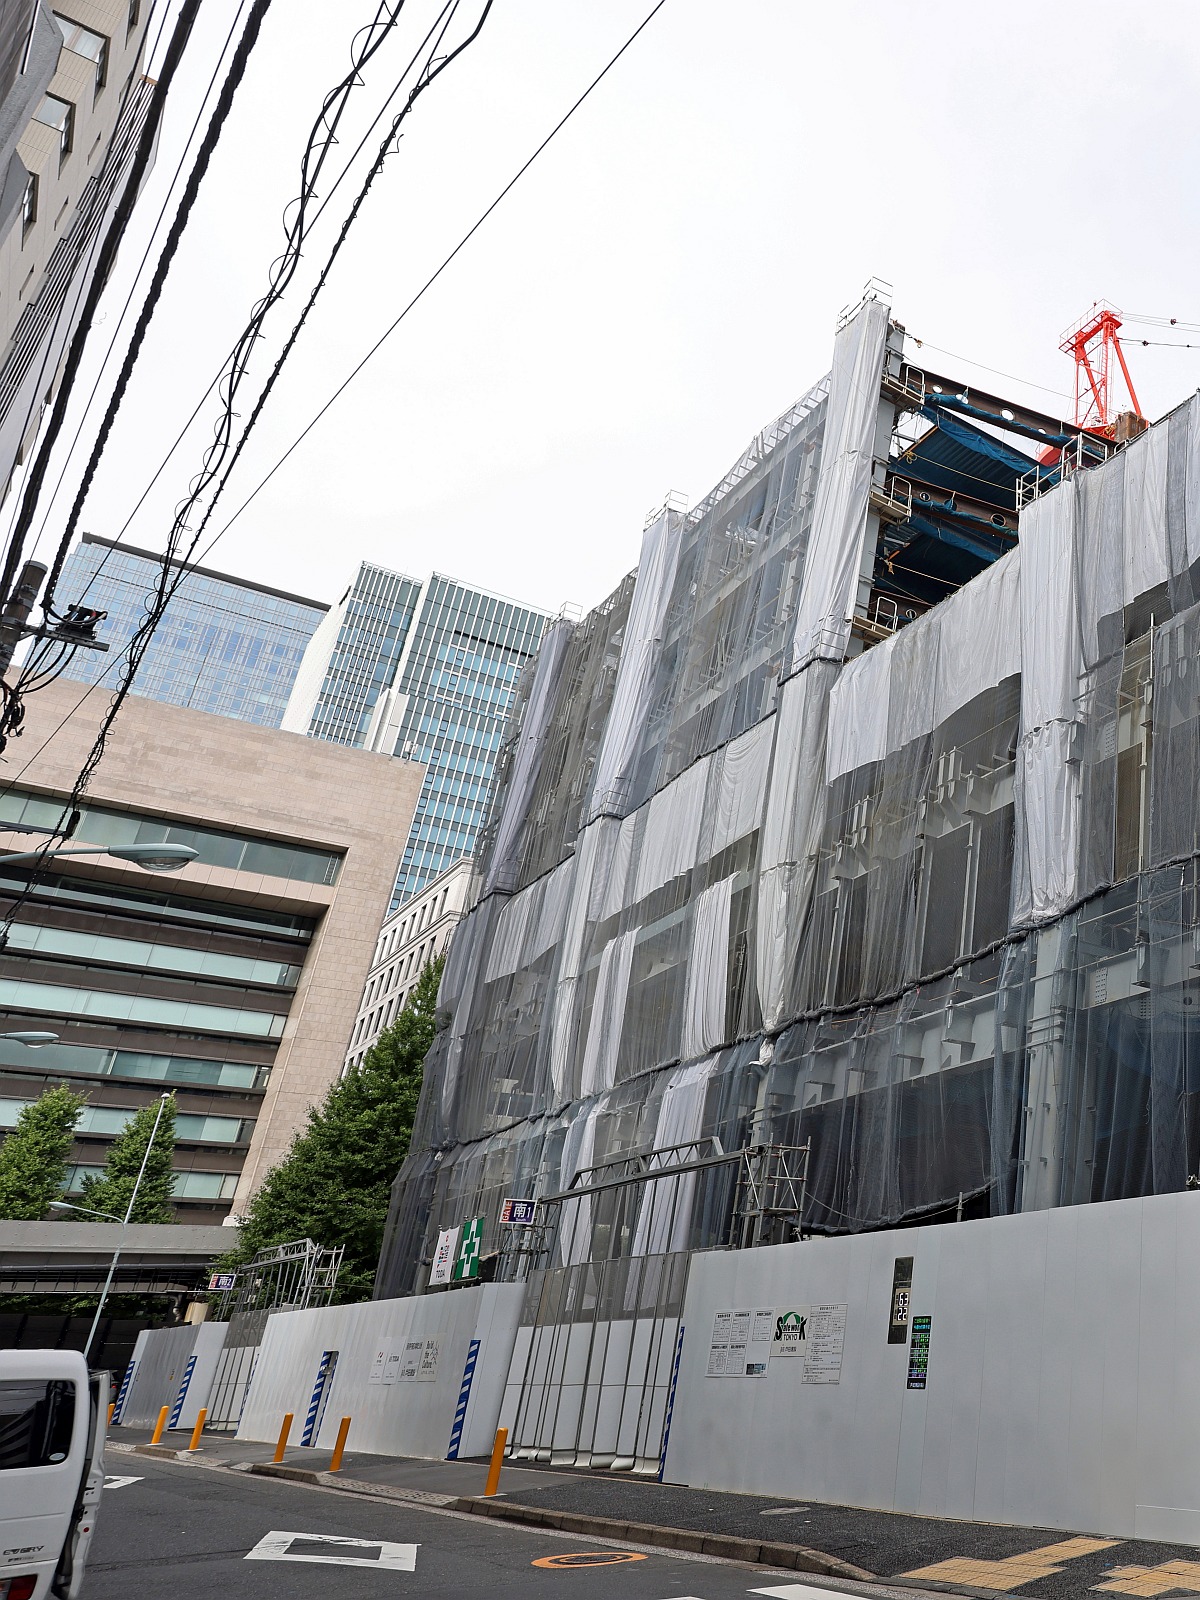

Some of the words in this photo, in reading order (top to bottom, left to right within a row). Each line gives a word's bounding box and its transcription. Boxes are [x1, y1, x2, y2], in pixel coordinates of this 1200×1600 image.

[503, 1201, 513, 1221] GATE
[899, 1292, 909, 1306] 63
[897, 1307, 908, 1321] 22
[3, 1546, 44, 1555] EVERY
